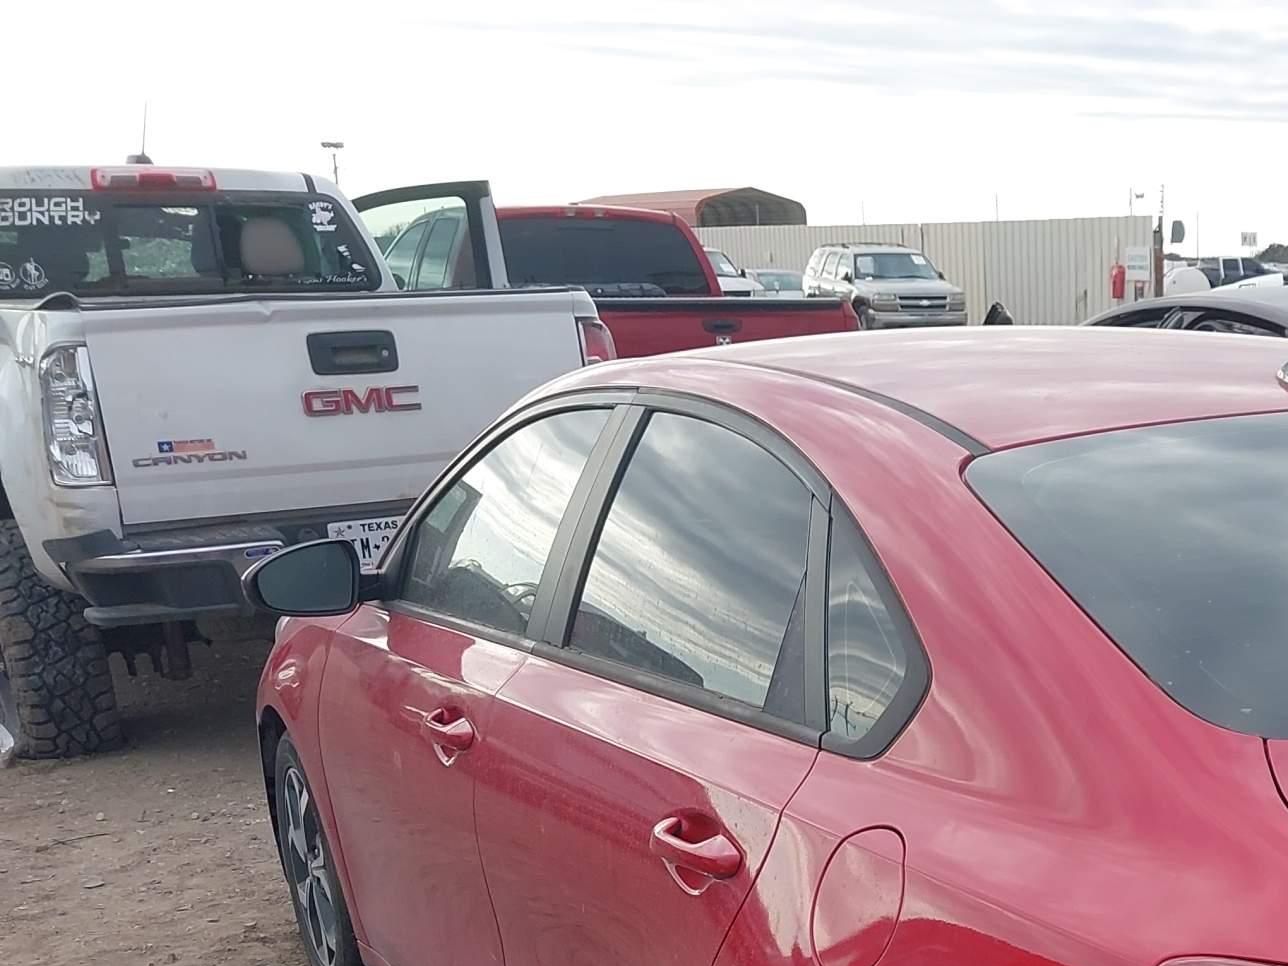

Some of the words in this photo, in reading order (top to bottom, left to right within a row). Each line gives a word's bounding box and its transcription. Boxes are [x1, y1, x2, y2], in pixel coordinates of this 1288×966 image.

[0, 211, 101, 226] OUNTRY
[302, 385, 422, 417] GMC
[132, 450, 248, 468] CANYON
[359, 520, 399, 533] TEXAS
